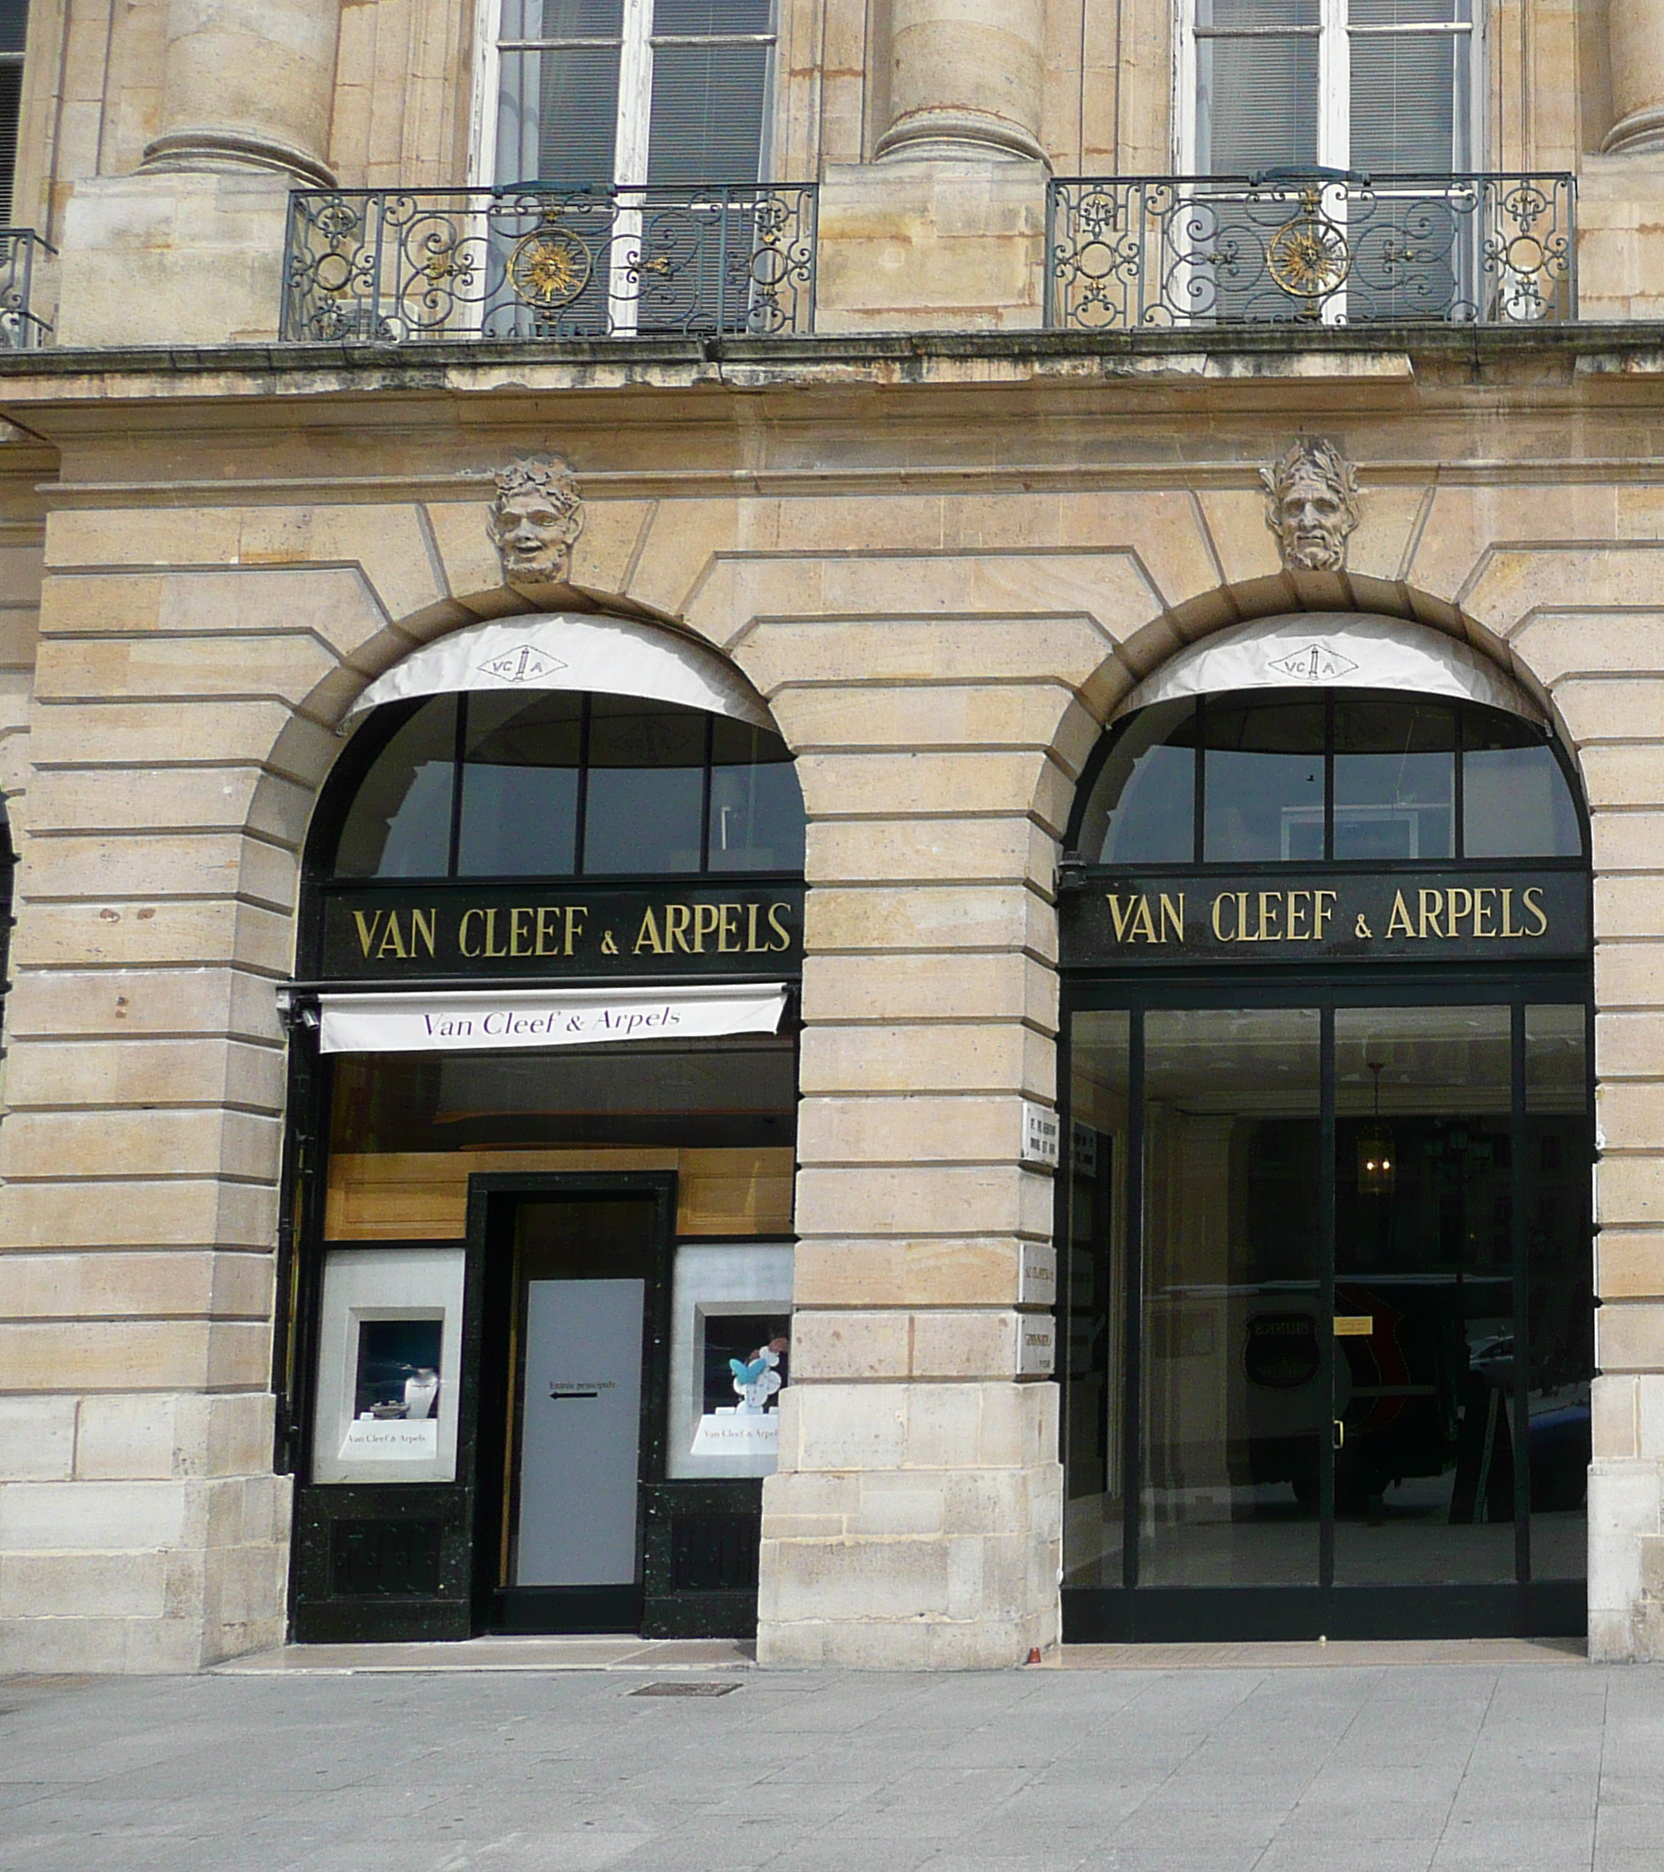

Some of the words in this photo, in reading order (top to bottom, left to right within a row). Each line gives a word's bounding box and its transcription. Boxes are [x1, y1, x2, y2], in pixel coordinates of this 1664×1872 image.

[492, 661, 513, 672] VC
[530, 662, 542, 673] A
[1284, 661, 1306, 673] VC
[1322, 662, 1335, 674] A
[353, 907, 437, 959] VAN
[458, 906, 588, 957] CLEEF
[600, 929, 619, 955] &
[632, 902, 792, 954] ARPELS
[1106, 893, 1185, 944] VAN
[1211, 890, 1337, 942] CLEEF
[1355, 914, 1373, 938] &
[1385, 887, 1548, 939] ARPELS
[424, 1012, 472, 1037] Van
[483, 1011, 560, 1035] Cleef
[566, 1015, 584, 1032] &
[596, 1007, 681, 1033] Arpels
